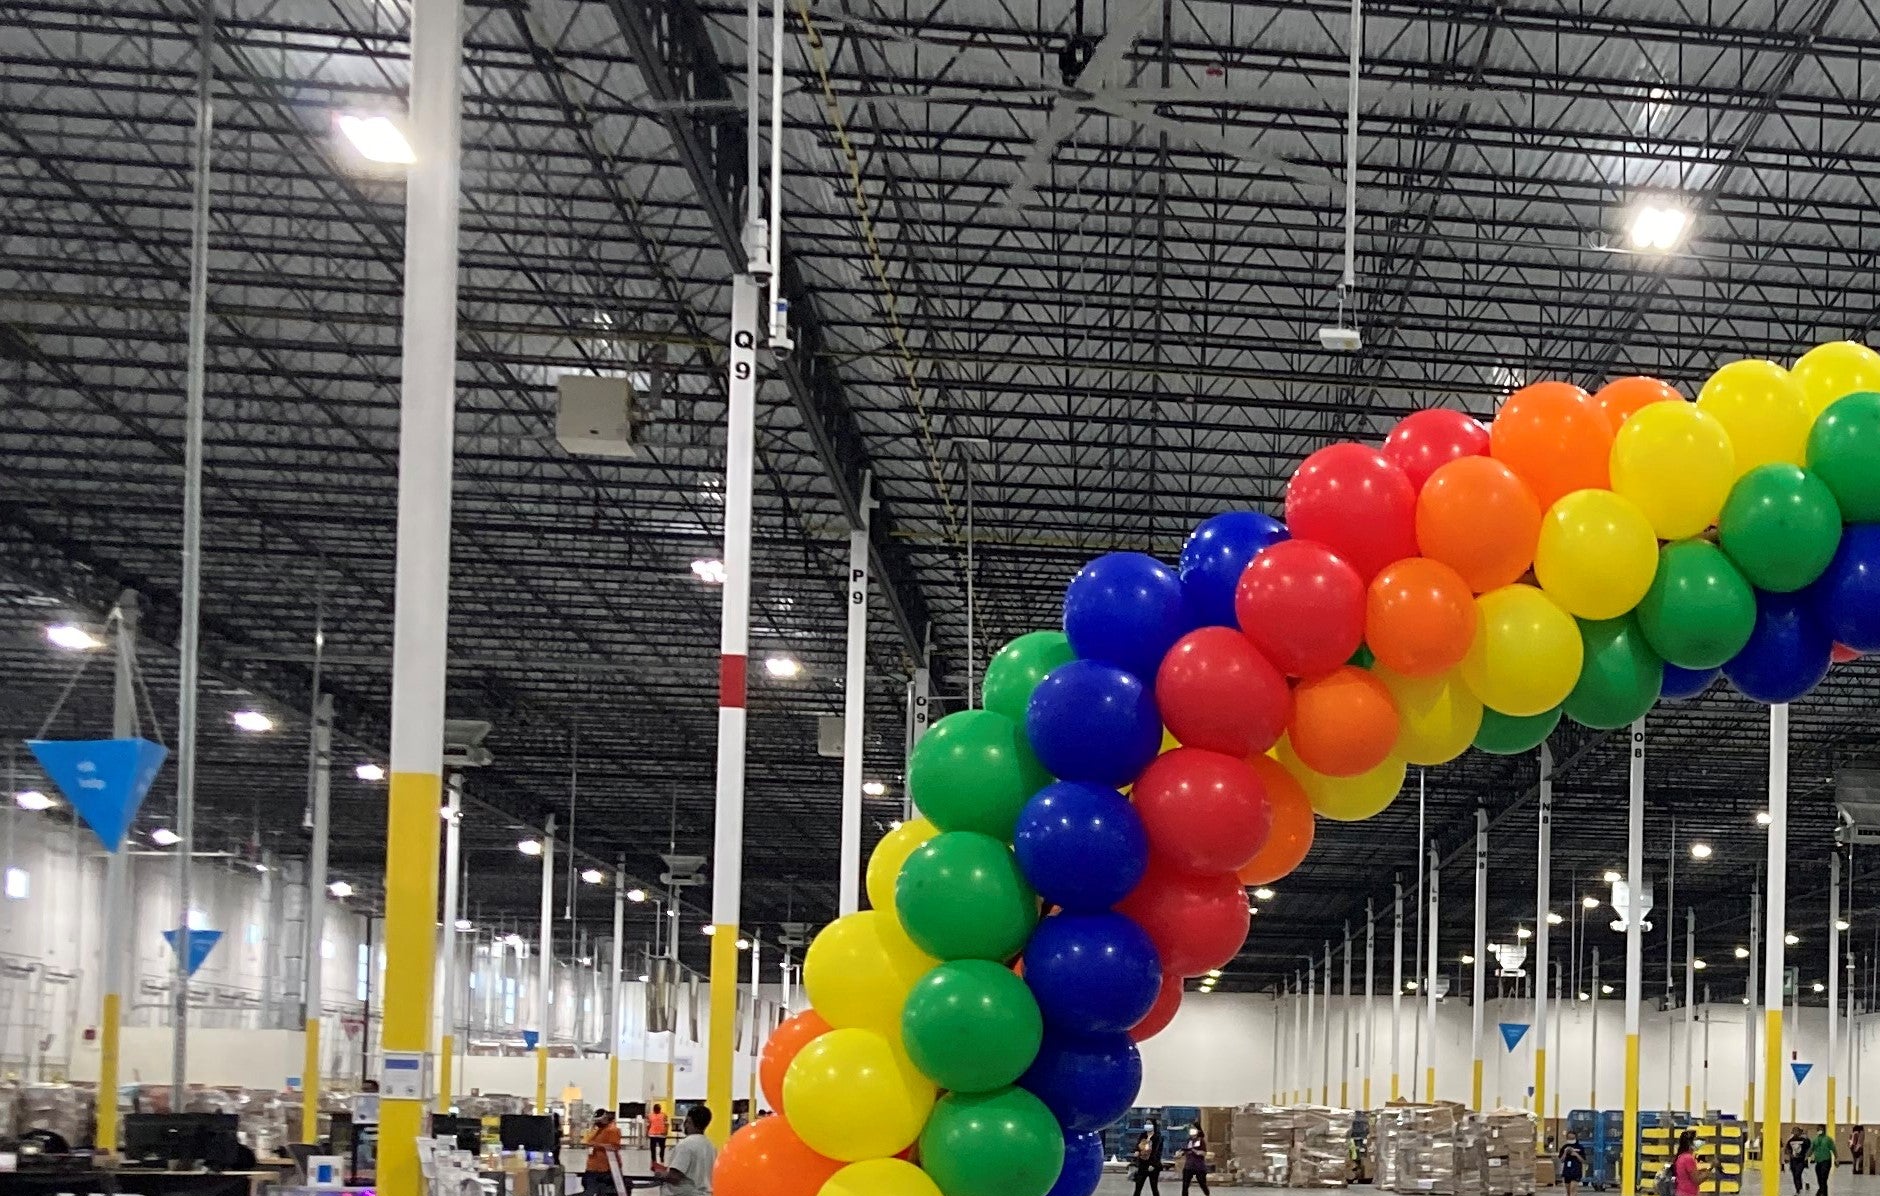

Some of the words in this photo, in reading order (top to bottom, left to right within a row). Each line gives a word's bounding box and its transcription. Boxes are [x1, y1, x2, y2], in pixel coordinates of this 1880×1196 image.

[735, 330, 754, 350] Q
[735, 362, 751, 379] 9
[853, 569, 863, 582] P
[853, 591, 863, 604] 9
